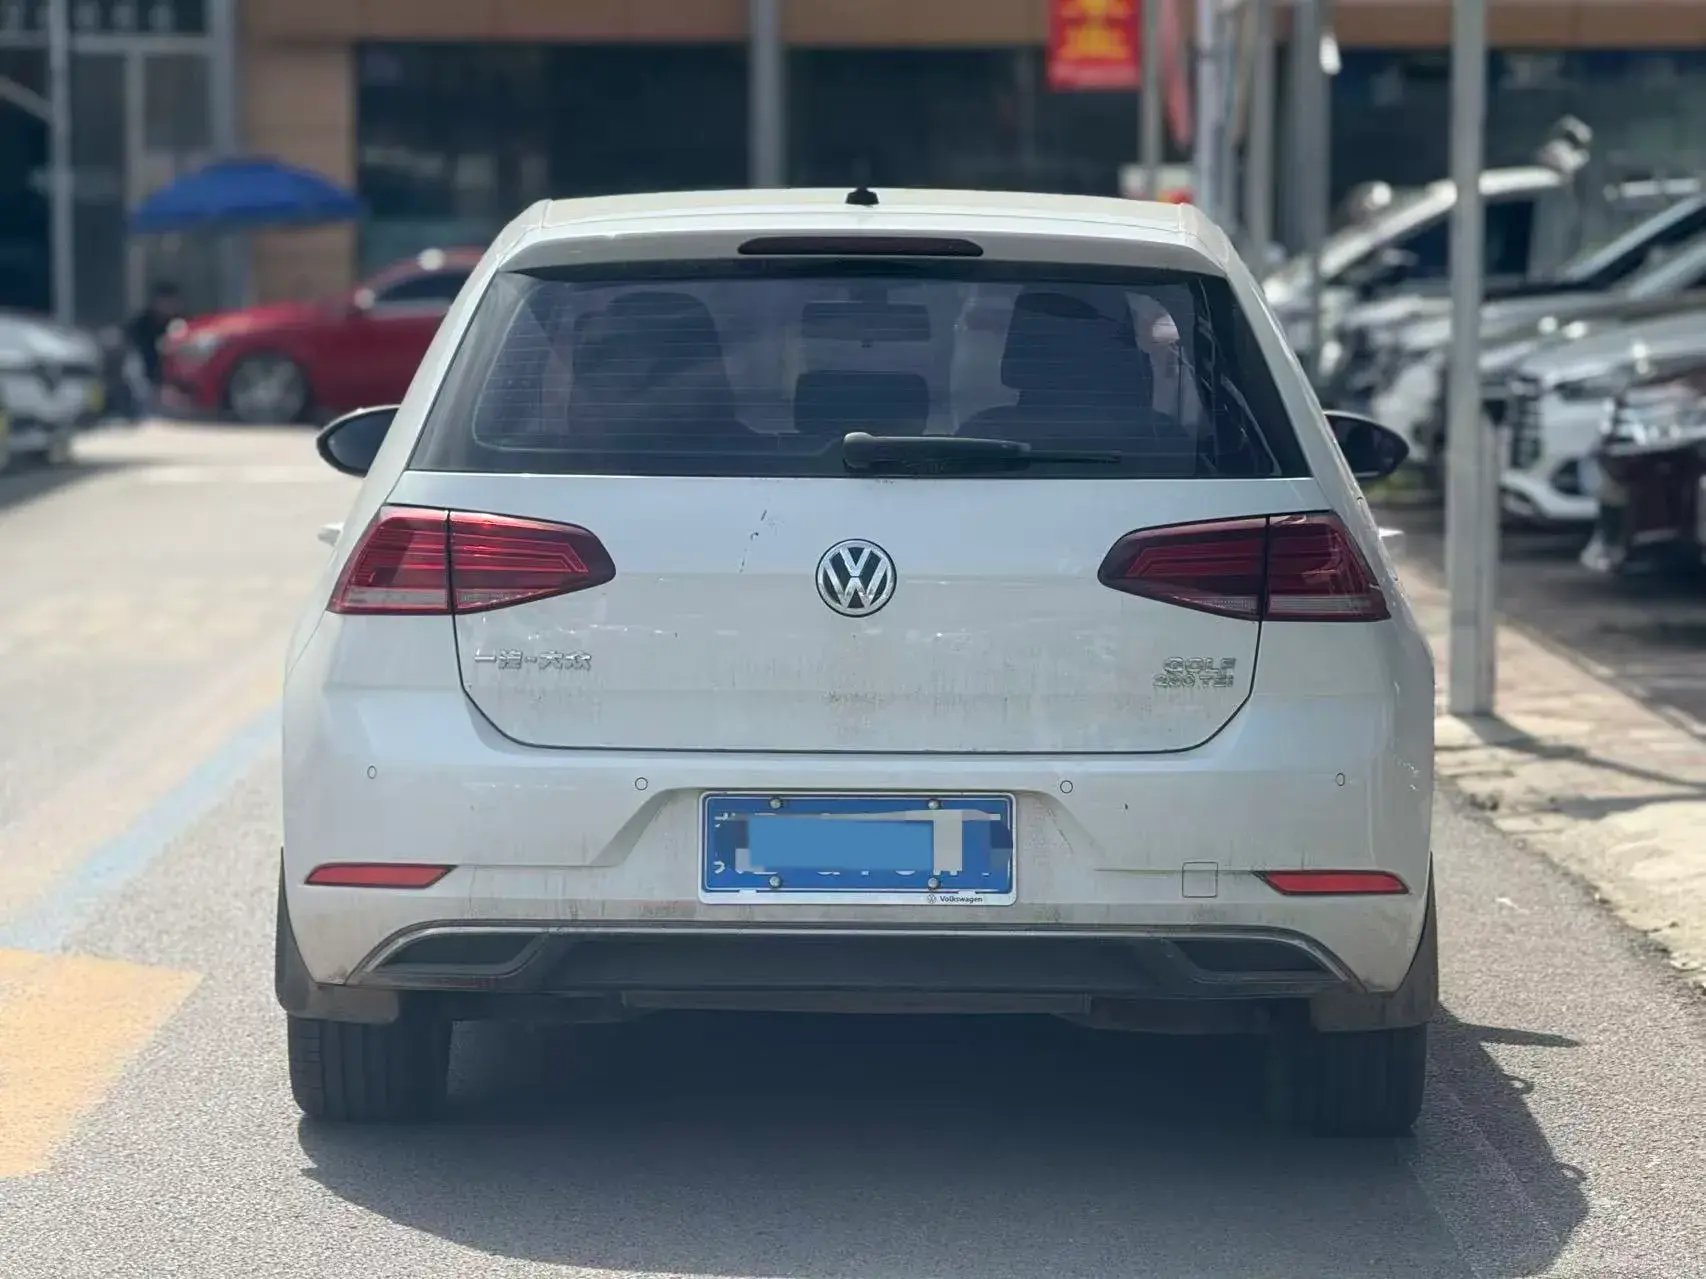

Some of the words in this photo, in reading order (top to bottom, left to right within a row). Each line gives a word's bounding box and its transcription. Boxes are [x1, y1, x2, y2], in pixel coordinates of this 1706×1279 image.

[819, 541, 893, 613] VW
[1163, 656, 1236, 674] GOLF
[940, 895, 983, 904] Volkswagen
